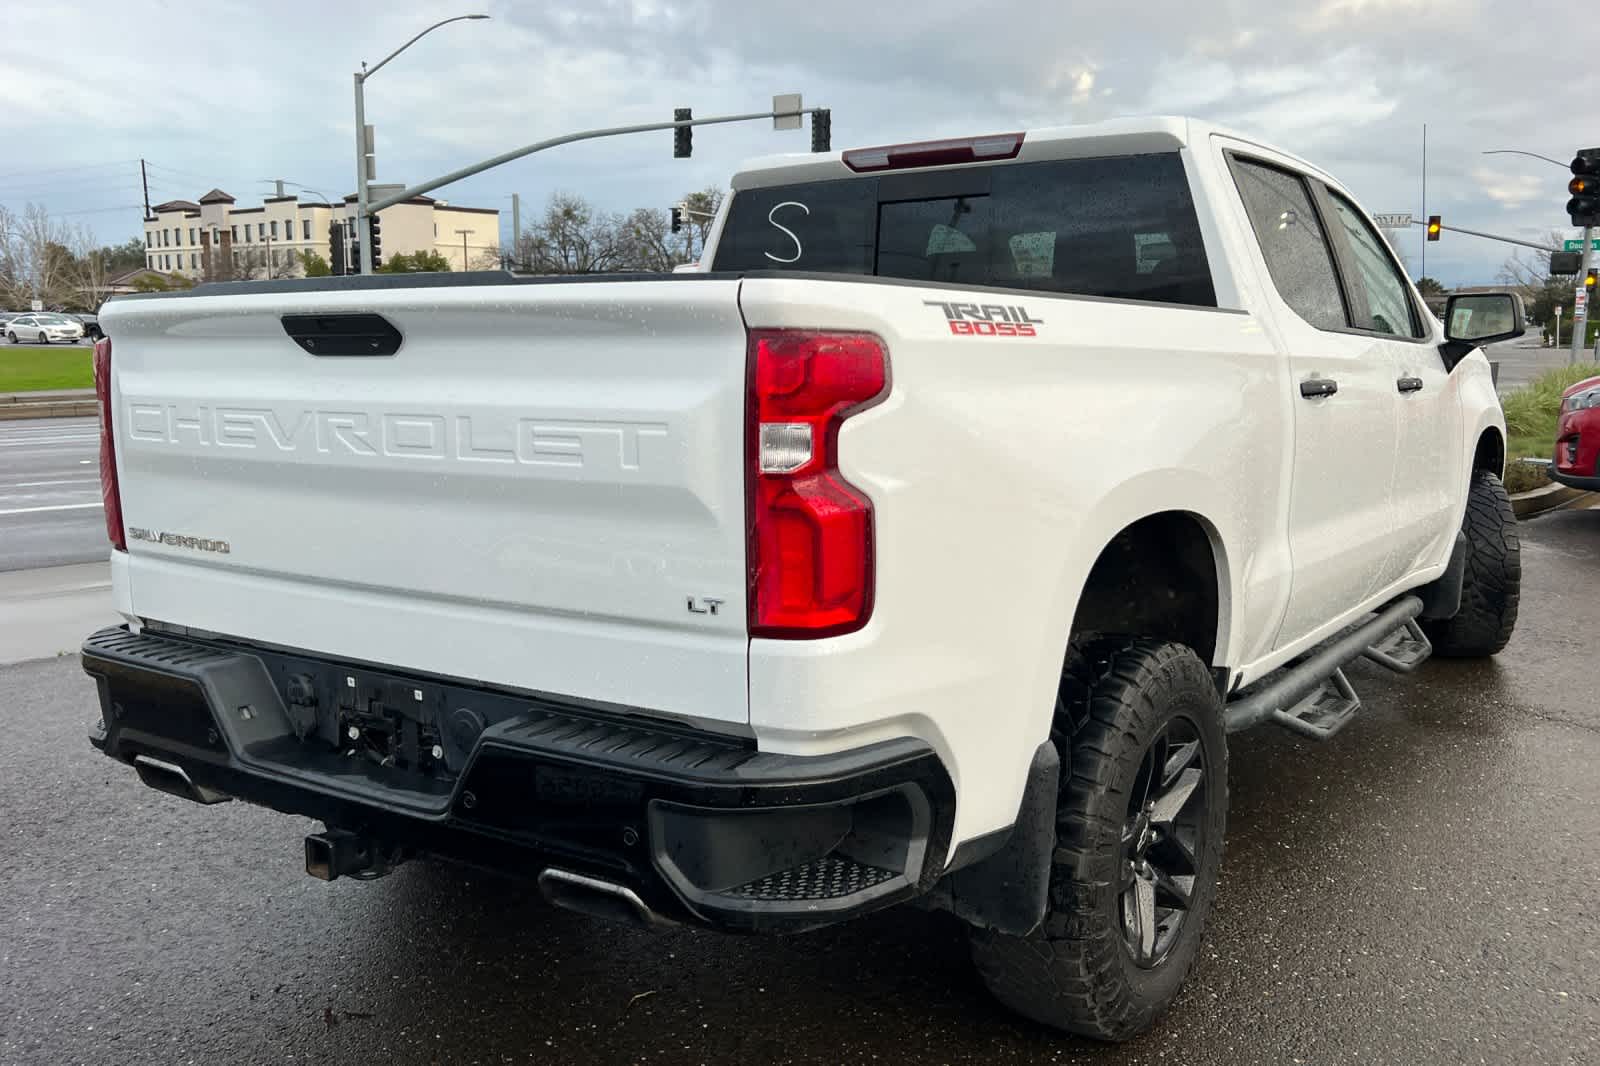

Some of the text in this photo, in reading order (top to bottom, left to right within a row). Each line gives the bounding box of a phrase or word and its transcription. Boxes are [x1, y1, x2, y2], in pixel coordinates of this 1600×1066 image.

[764, 201, 810, 263] S
[922, 299, 1044, 324] TRAIL
[949, 319, 1037, 336] BOSS
[128, 403, 669, 470] CHEVROLET
[128, 527, 230, 553] SILVERADO
[687, 595, 724, 616] LT
